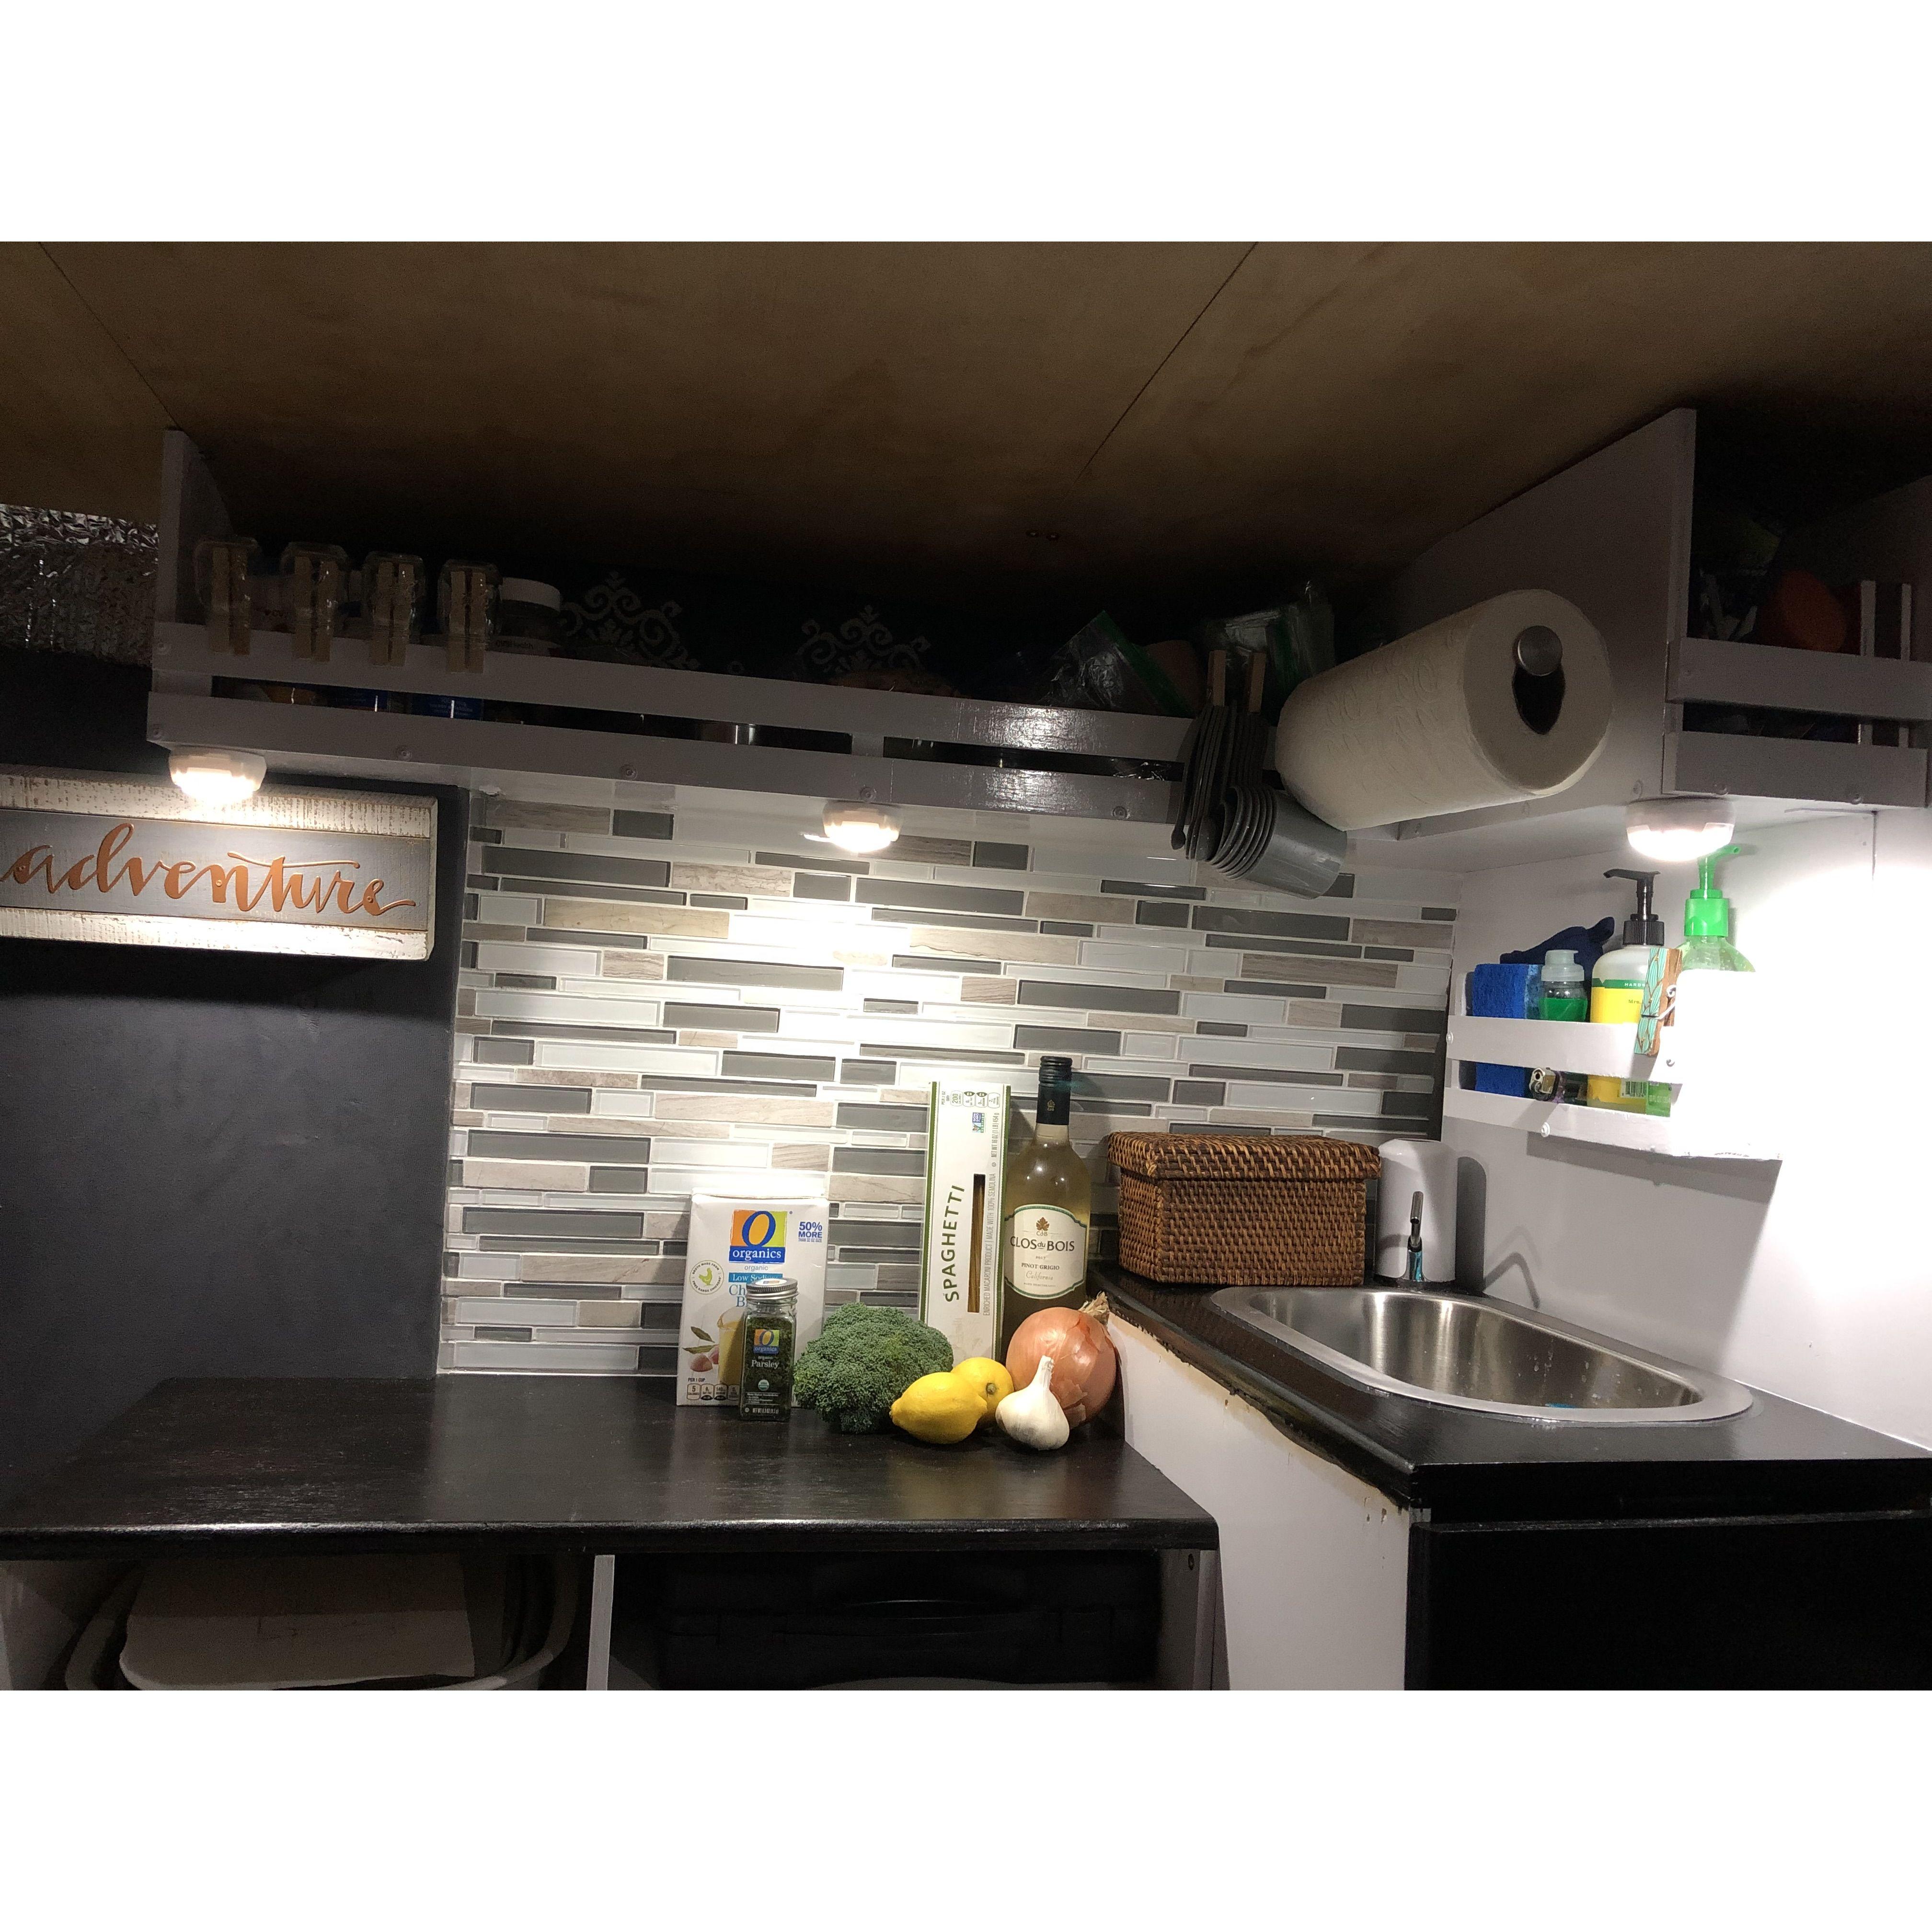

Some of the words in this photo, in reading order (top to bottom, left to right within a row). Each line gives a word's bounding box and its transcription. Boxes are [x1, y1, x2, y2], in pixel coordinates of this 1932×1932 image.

[0, 823, 416, 916] adventure
[988, 1173, 996, 1197] SEMOLINA
[987, 1197, 995, 1211] 100%
[742, 1210, 776, 1246] O
[799, 1221, 822, 1231] 50%
[941, 1185, 965, 1302] SPAGHETTI
[1010, 1236, 1037, 1250] CLOS
[1037, 1241, 1046, 1249] du
[1046, 1240, 1075, 1252] BOIS
[732, 1248, 782, 1261] organics
[985, 1243, 993, 1265] PRODUCT
[983, 1266, 991, 1291] MACARONI
[1026, 1270, 1054, 1281] California
[751, 1359, 780, 1369] Parsley
